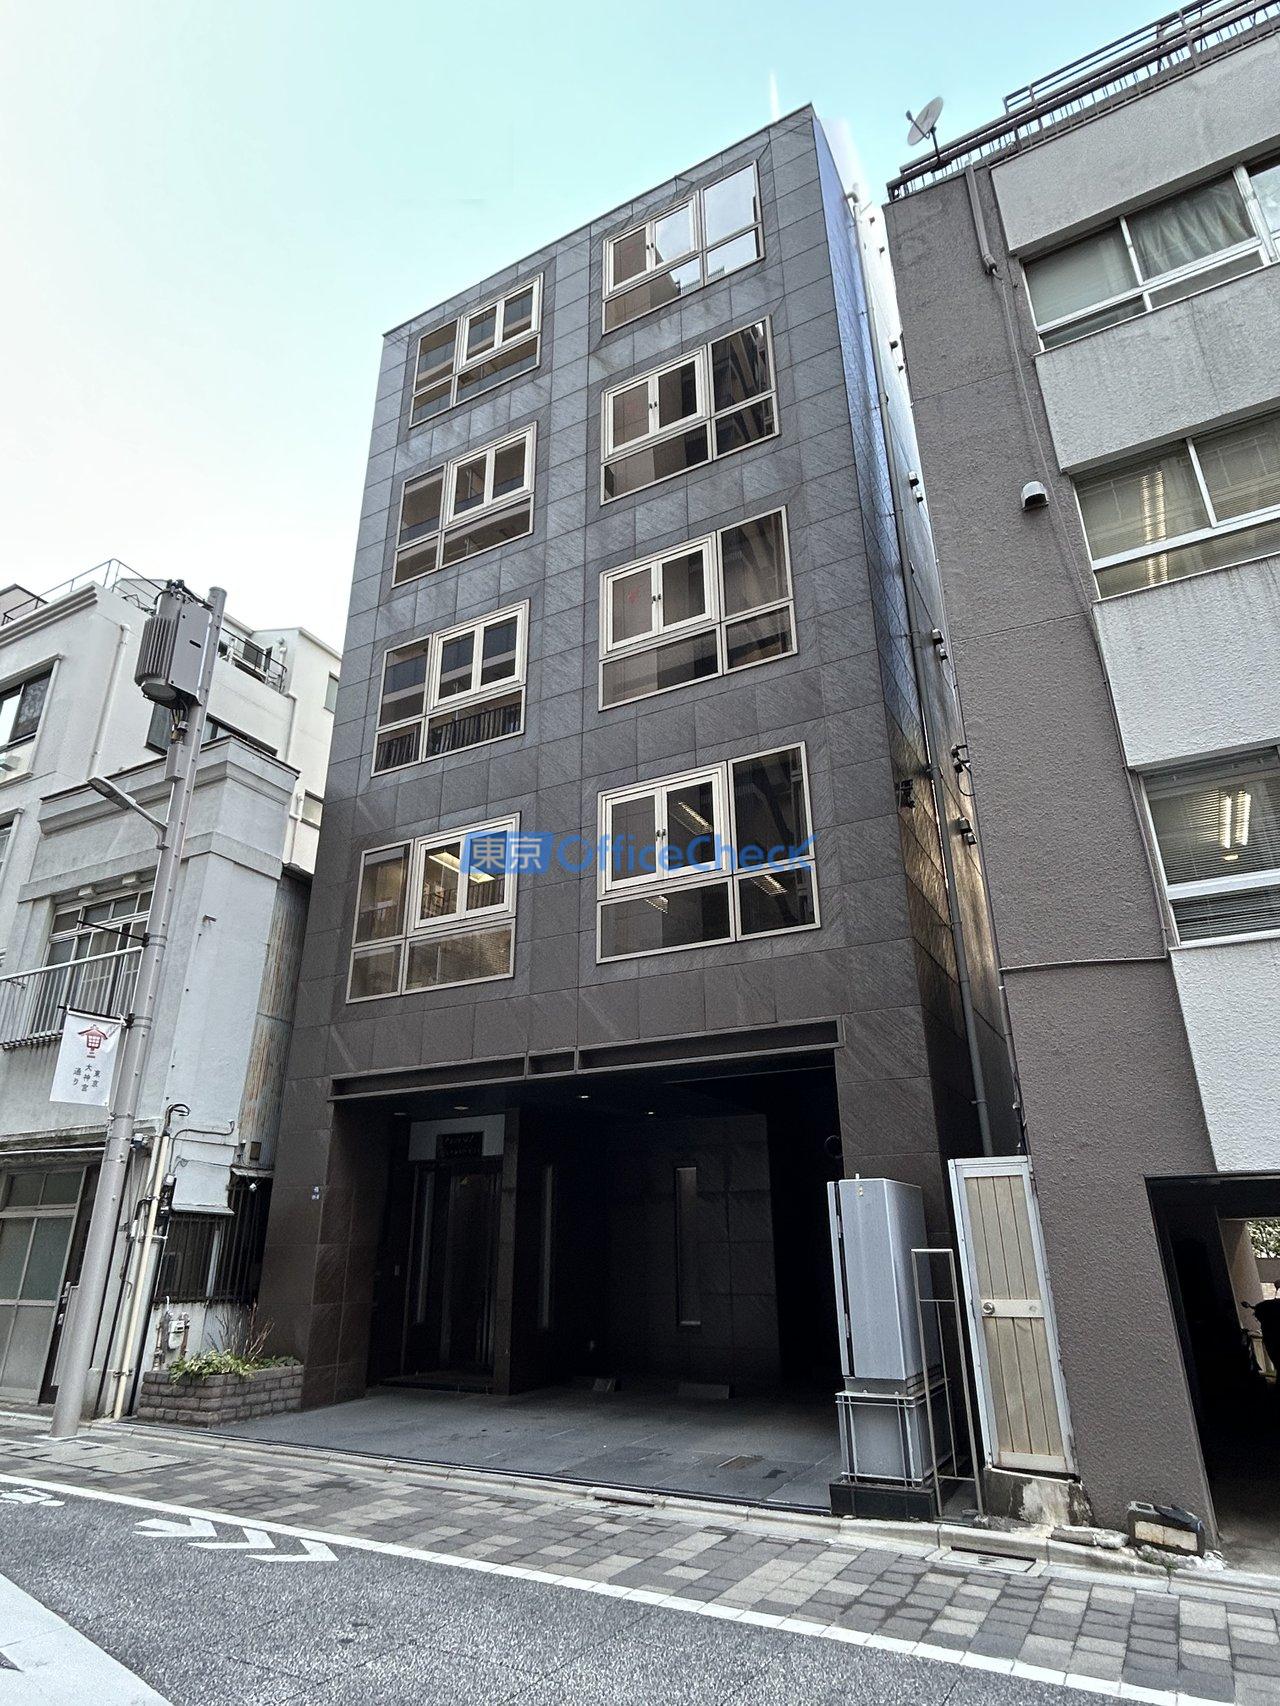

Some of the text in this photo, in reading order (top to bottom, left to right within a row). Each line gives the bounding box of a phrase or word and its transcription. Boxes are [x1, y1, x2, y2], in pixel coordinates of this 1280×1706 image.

[73, 1067, 81, 1085] 通り
[81, 1064, 92, 1091] 大神宮
[91, 1069, 101, 1087] 東京
